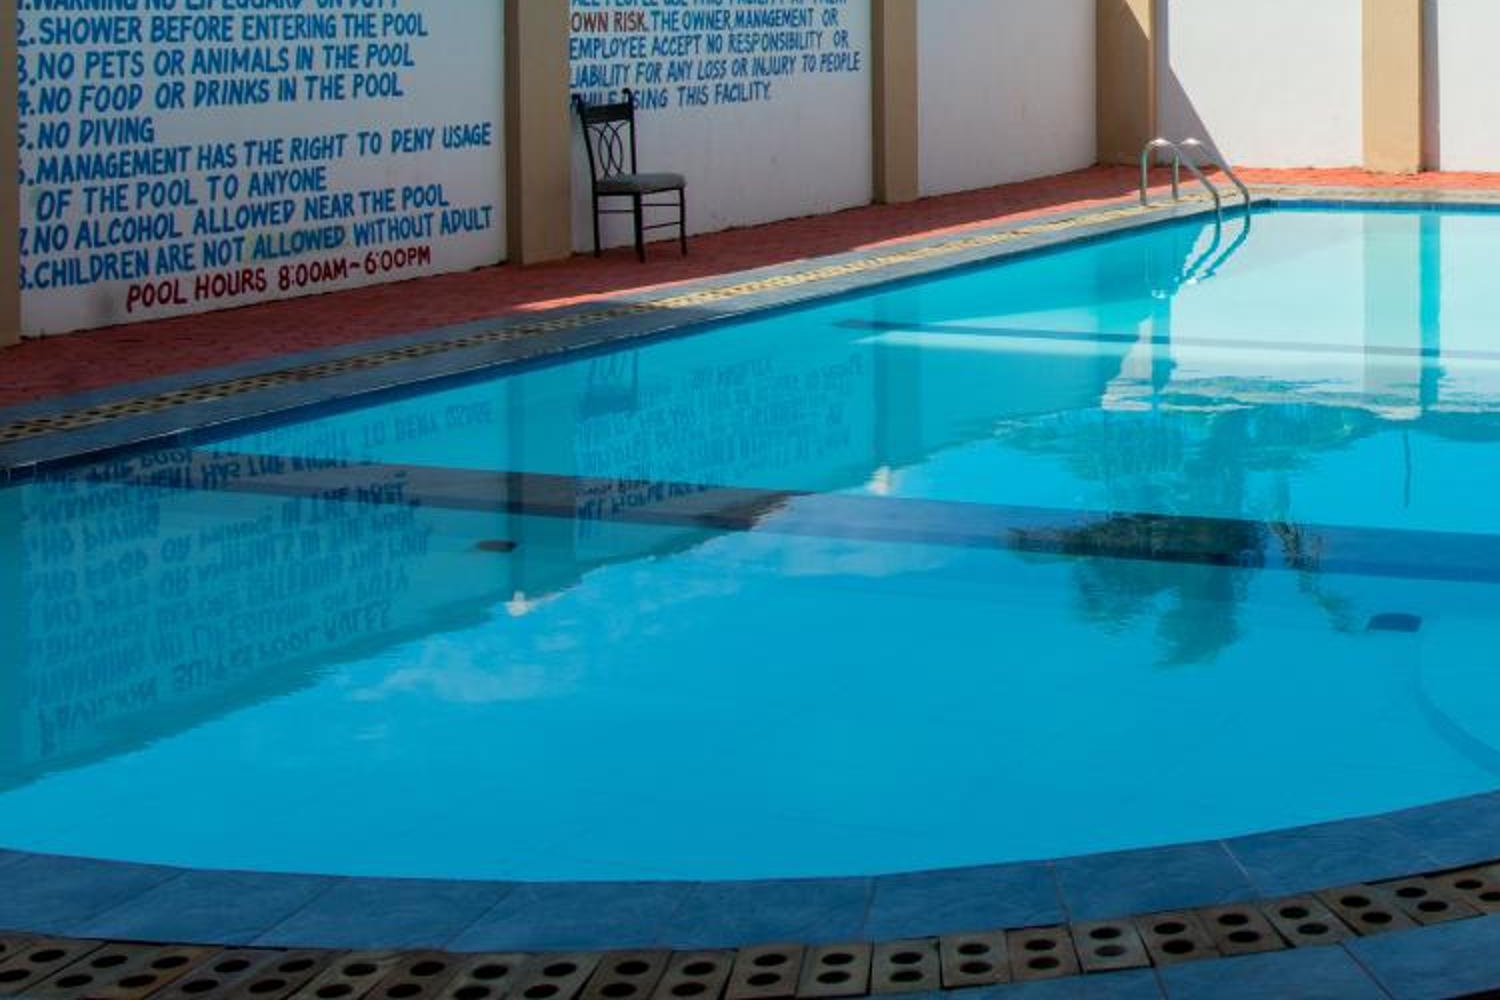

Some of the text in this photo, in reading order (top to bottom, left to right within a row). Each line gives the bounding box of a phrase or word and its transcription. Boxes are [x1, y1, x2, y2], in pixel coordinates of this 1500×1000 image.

[151, 16, 234, 43] BEFORE
[243, 15, 336, 41] ENTERING
[344, 14, 377, 38] THE
[383, 13, 428, 37] POOL
[571, 12, 608, 32] OWN
[652, 10, 679, 31] THE
[735, 8, 813, 27] MANAGEMENT
[822, 8, 838, 25] OR
[85, 50, 144, 78] PETS
[154, 51, 185, 76] OR
[192, 46, 289, 74] ANIMALS
[296, 46, 314, 70] IN
[323, 44, 359, 67] THE
[366, 44, 414, 66] POOL
[570, 30, 849, 59] EMPLOYEE ACCEPT NO RESPONSIBILITY OR
[636, 62, 661, 83] FOR
[667, 61, 693, 80] ANY
[698, 59, 727, 79] LOSS
[732, 59, 747, 77] OR
[752, 56, 796, 76] INJURY
[802, 55, 816, 71] TO
[820, 52, 861, 71] PEOPLE
[79, 85, 142, 113] FOOD
[156, 83, 184, 109] OR
[194, 78, 269, 106] DRINKS
[278, 76, 297, 102] IN
[306, 74, 344, 100] THE
[352, 73, 403, 98] POOL
[627, 88, 668, 111] SING
[678, 86, 709, 105] THIS
[79, 118, 154, 146] DIVING
[198, 141, 237, 169] HAS
[245, 138, 283, 166] THE
[290, 134, 344, 161] RIGHT
[358, 131, 383, 157] TO
[392, 128, 435, 153] DENY
[443, 123, 492, 148] USAGE
[37, 168, 327, 221] OF THE POOL TO ANYONE
[77, 211, 182, 250] ALCOHOL
[193, 198, 295, 235] ALLOWED
[305, 192, 354, 221] NEAR
[360, 189, 395, 215] THE
[402, 185, 449, 209] POOL
[156, 244, 194, 273] ARE
[203, 238, 245, 265] NOT
[252, 226, 345, 260] ALLOWED
[353, 213, 433, 247] WITHOUT
[440, 206, 492, 235] ADULT
[127, 278, 187, 312] POOL
[196, 265, 267, 301] HOURS
